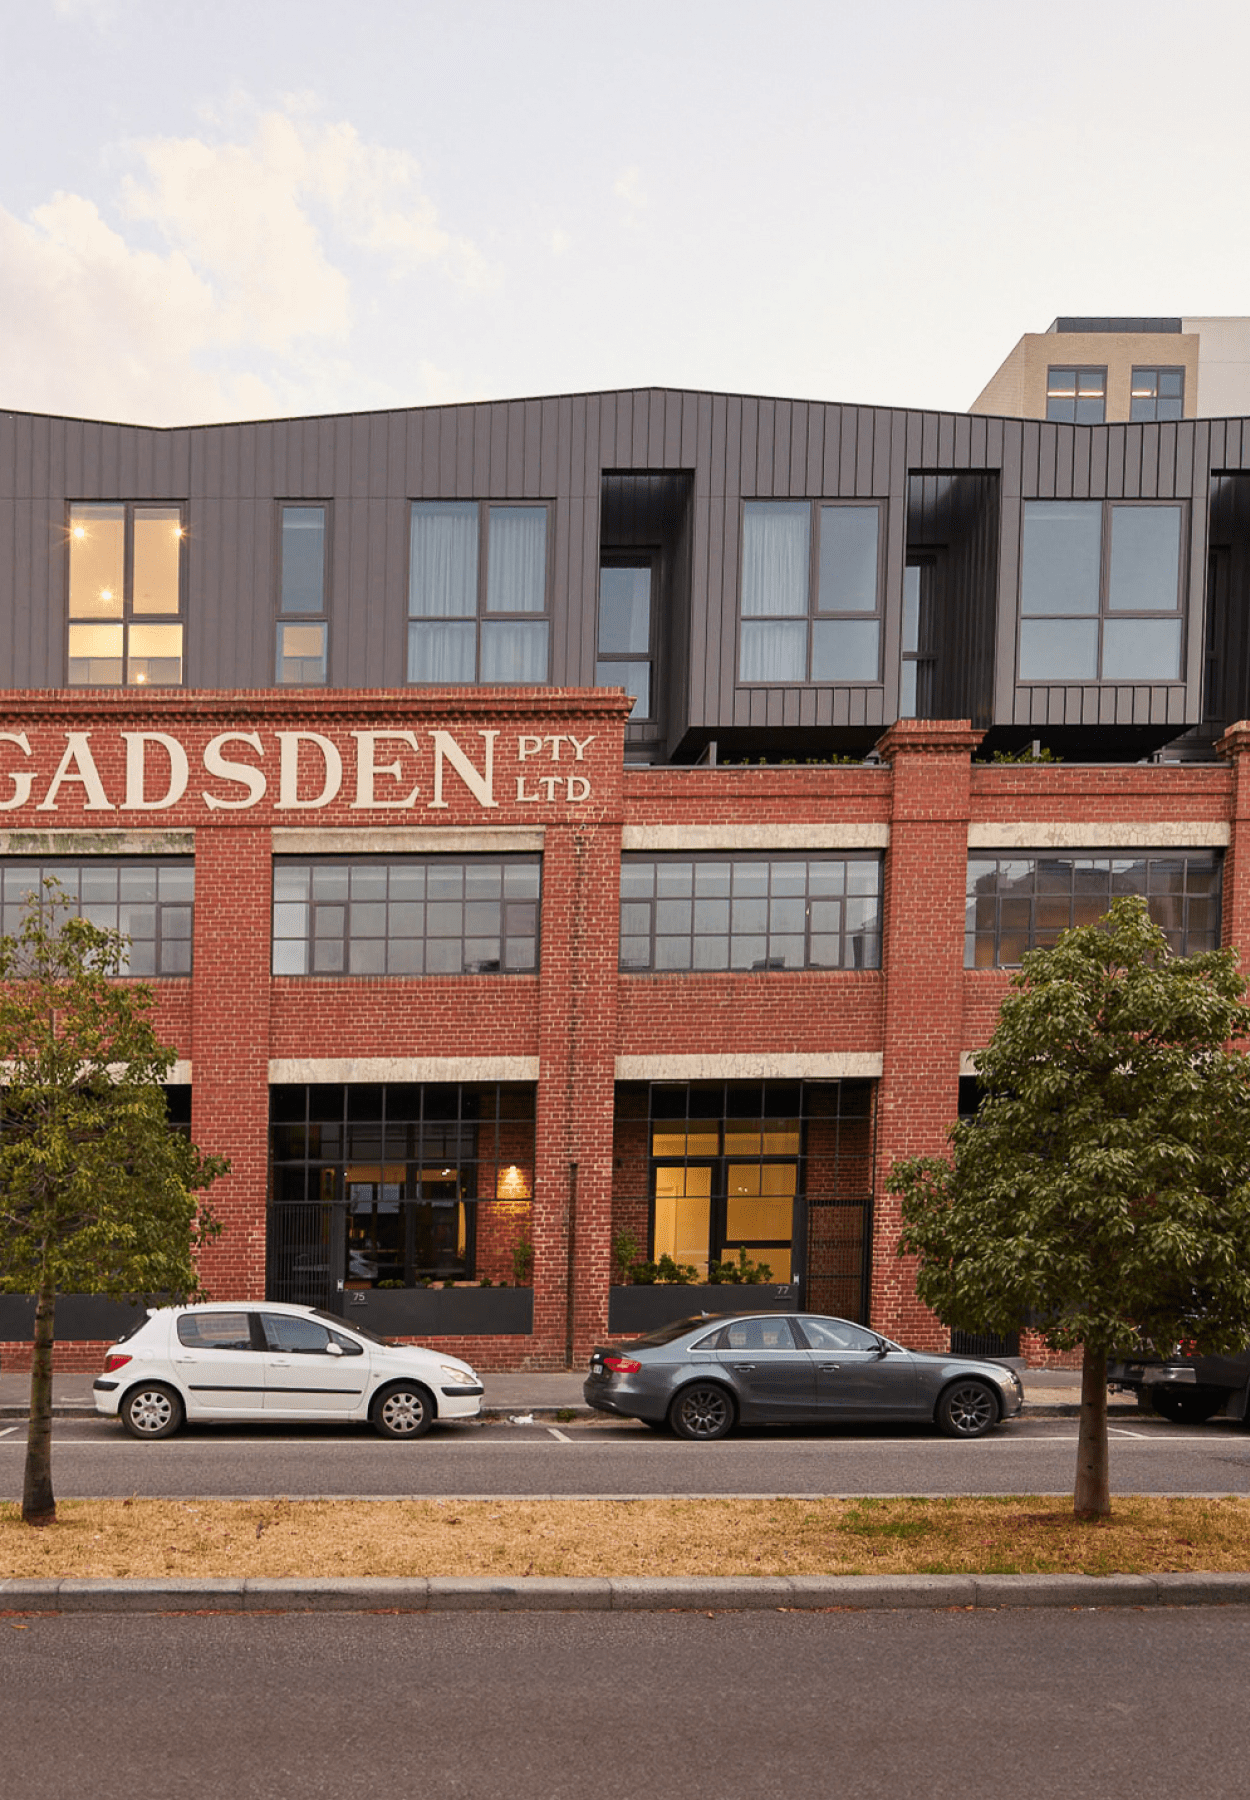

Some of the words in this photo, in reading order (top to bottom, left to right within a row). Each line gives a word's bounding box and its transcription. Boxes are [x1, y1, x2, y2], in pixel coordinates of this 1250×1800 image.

[518, 735, 596, 761] PTY
[515, 776, 591, 802] LTD
[353, 1292, 365, 1301] 75
[777, 1286, 789, 1295] 77
